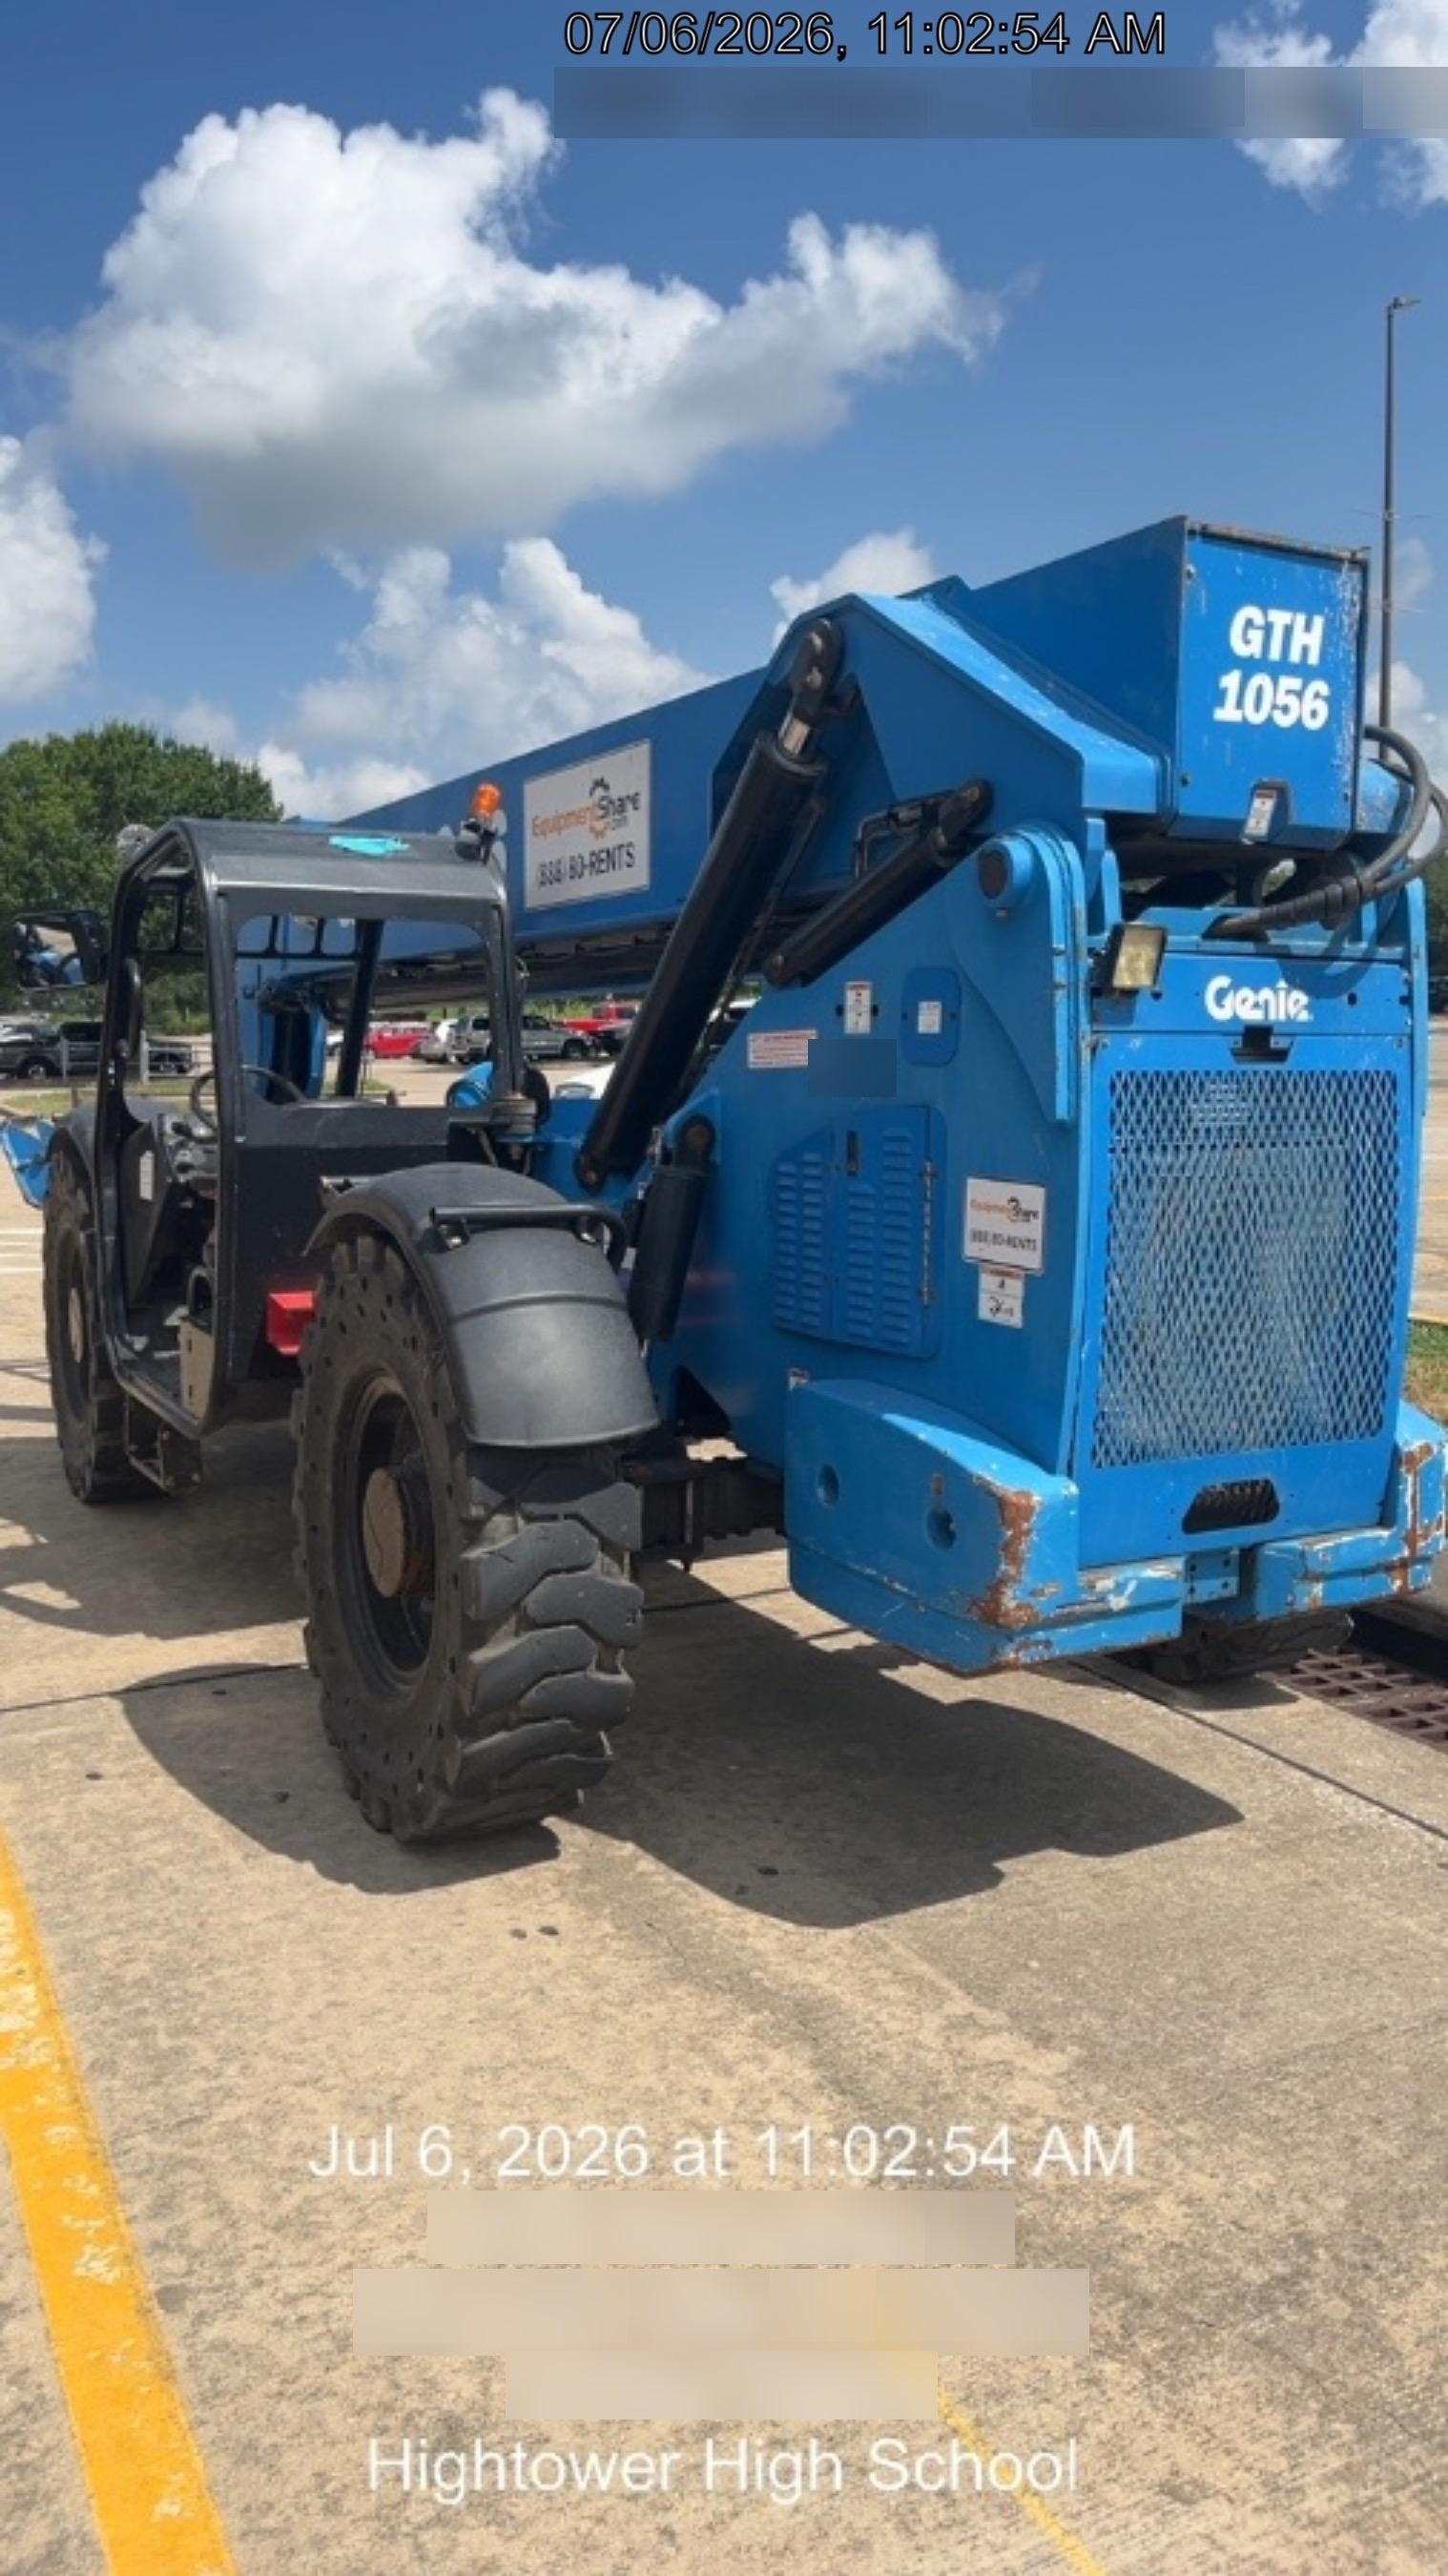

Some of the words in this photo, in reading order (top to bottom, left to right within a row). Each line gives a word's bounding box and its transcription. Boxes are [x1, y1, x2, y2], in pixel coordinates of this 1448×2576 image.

[1230, 606, 1324, 666] GTH
[1212, 669, 1331, 731] 1056
[1204, 974, 1311, 1023] Genie
